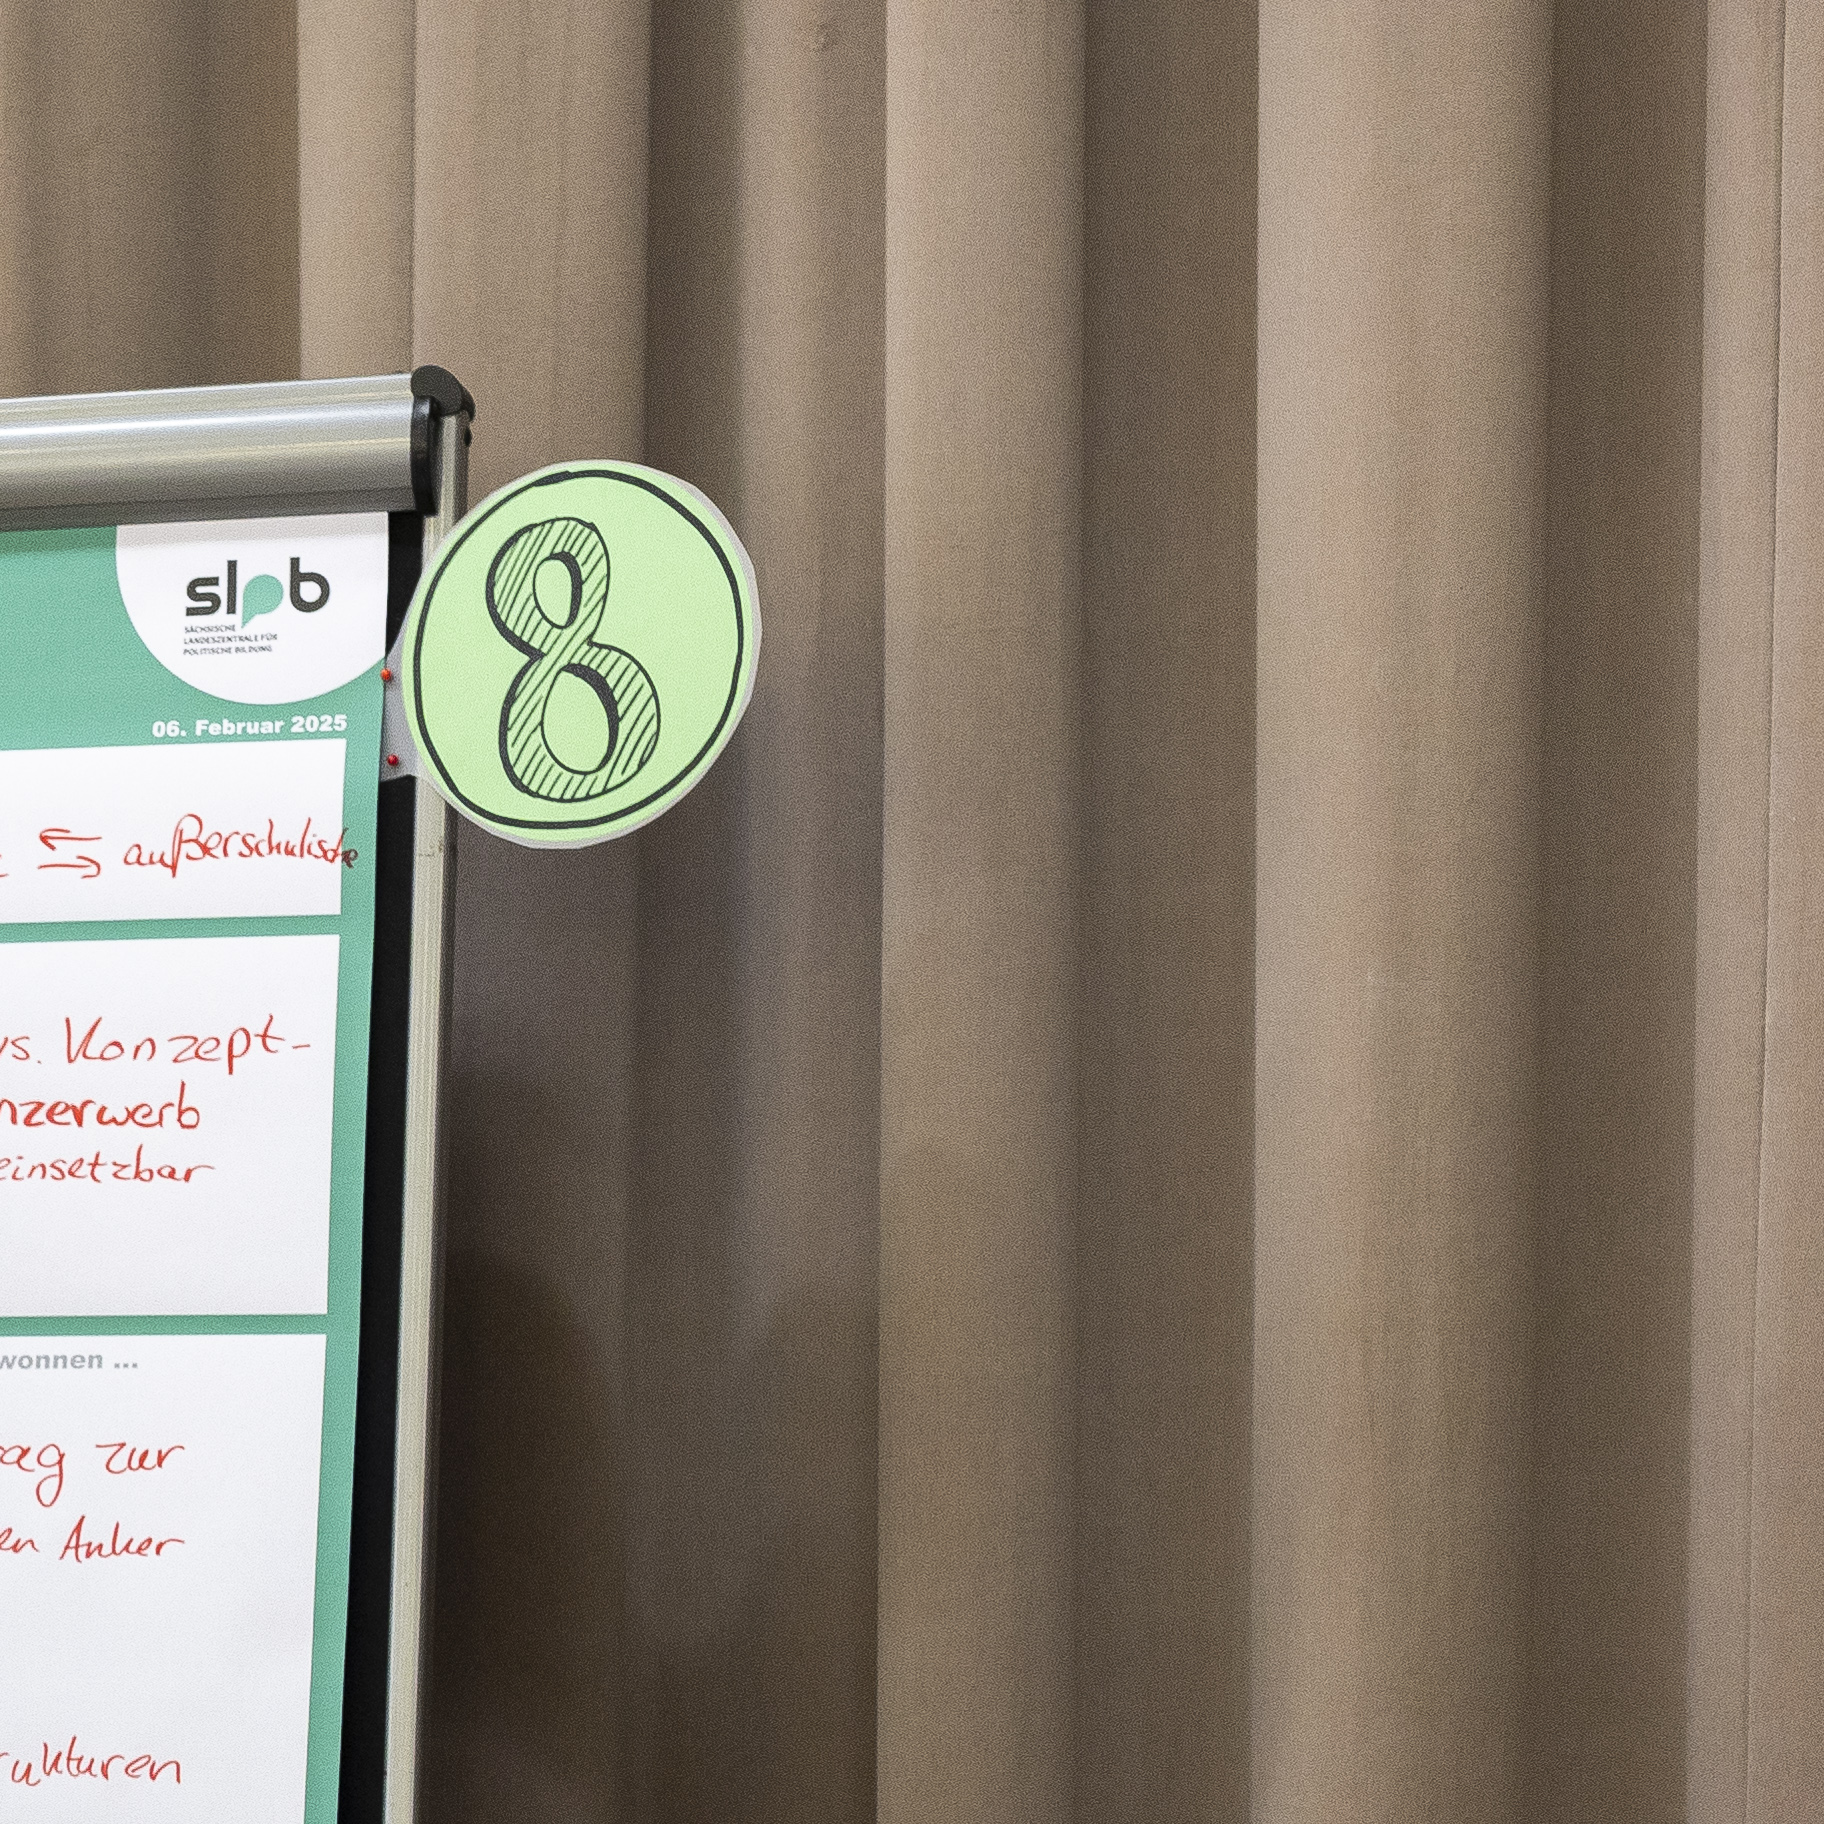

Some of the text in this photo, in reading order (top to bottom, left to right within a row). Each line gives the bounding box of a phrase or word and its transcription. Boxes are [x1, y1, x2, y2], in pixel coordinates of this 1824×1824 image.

[186, 557, 330, 628] slpb
[486, 517, 660, 803] 8
[152, 714, 348, 738] 06. Februar 2025
[96, 1441, 186, 1474] zur
[59, 1515, 186, 1564] Anker
